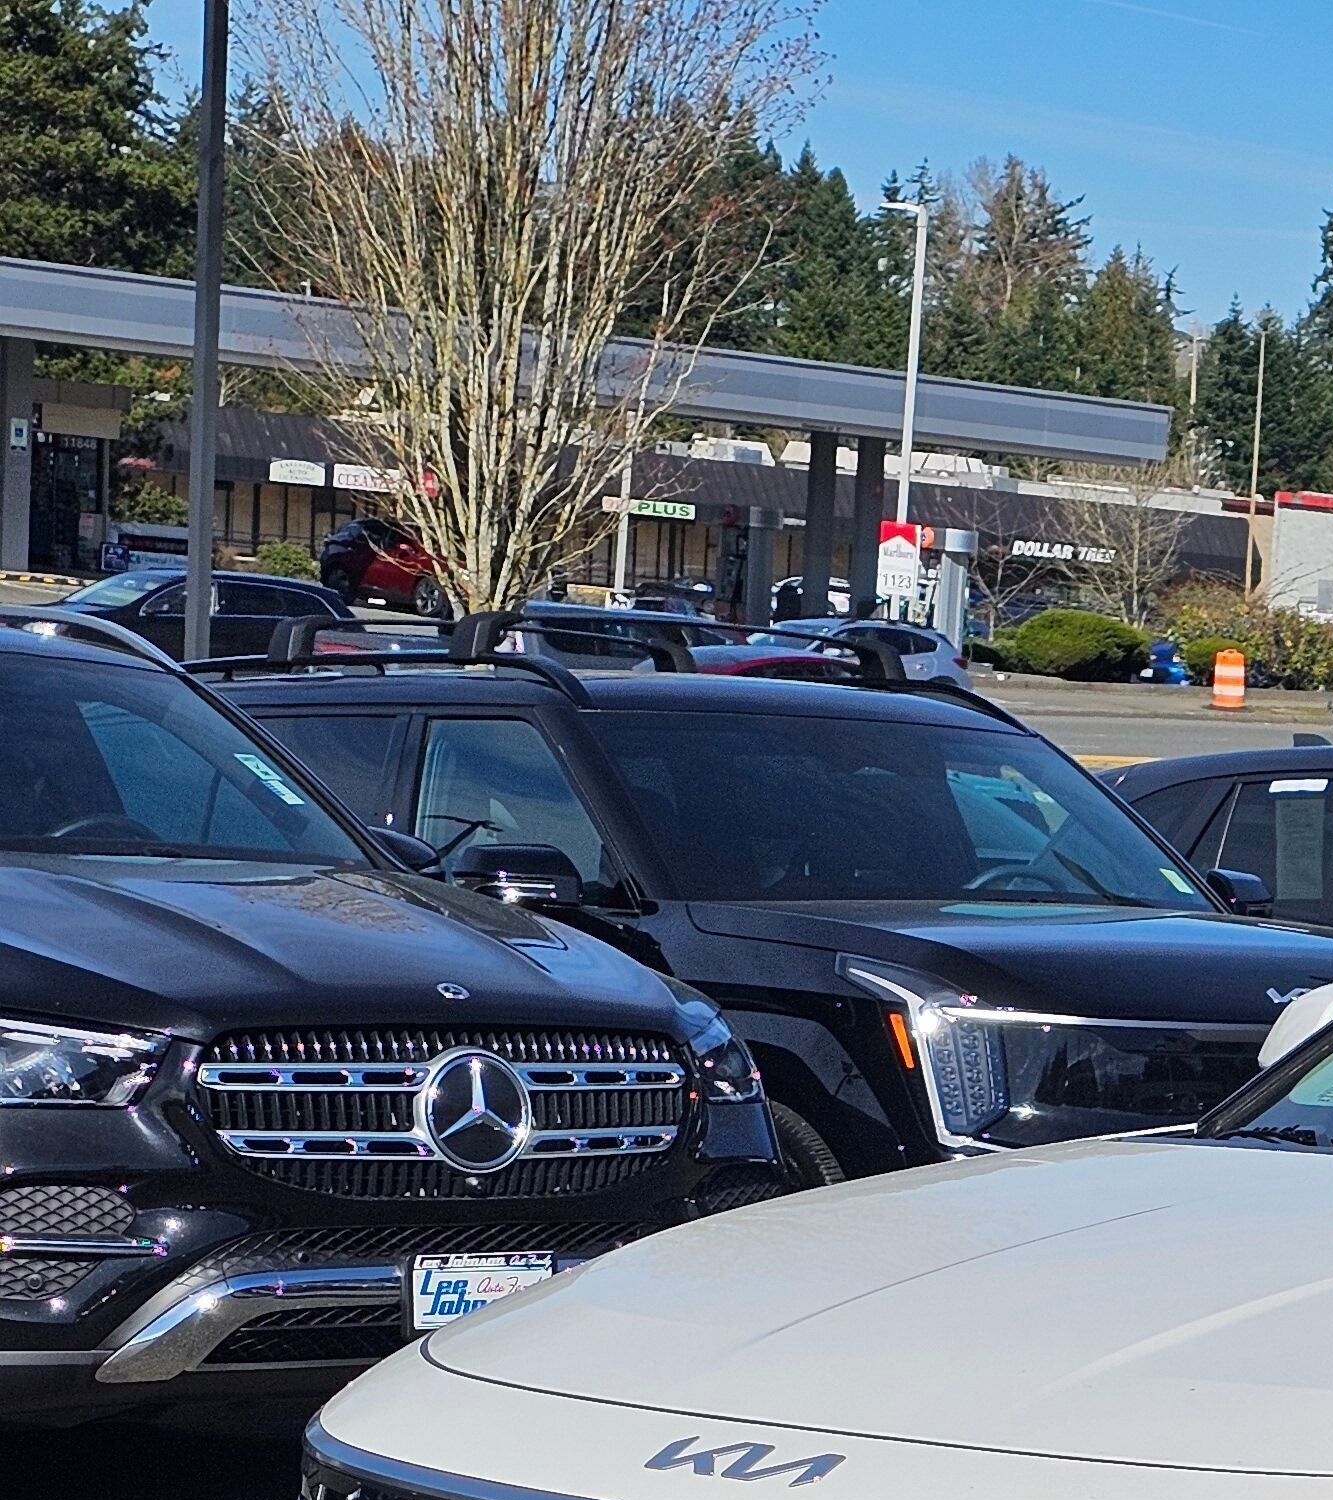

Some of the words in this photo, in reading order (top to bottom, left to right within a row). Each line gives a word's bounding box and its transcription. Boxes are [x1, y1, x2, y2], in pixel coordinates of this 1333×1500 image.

[637, 502, 690, 517] PLUS
[1011, 540, 1075, 560] DOLLAR
[420, 1270, 470, 1295] Lee
[477, 1277, 505, 1294] Auto
[423, 1281, 487, 1316] John
[644, 1435, 847, 1488] KIA
